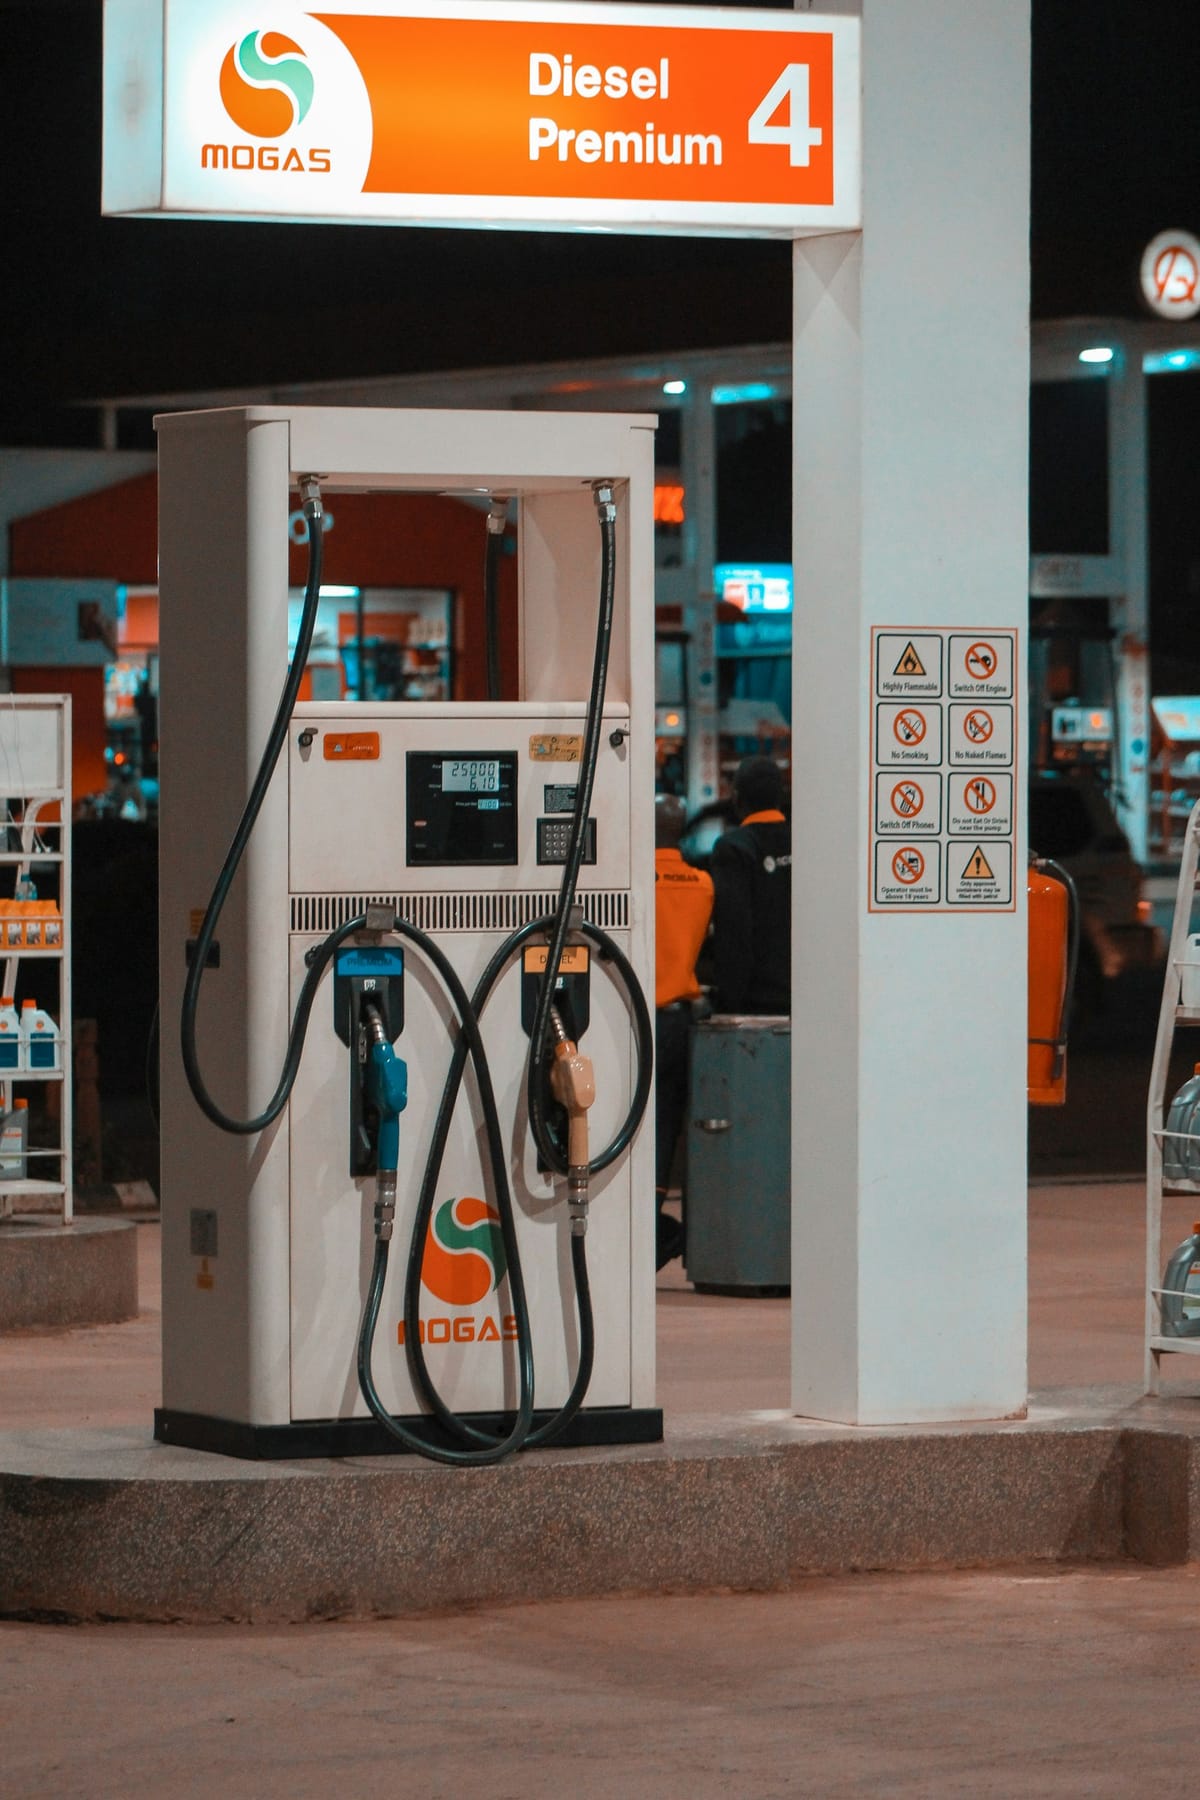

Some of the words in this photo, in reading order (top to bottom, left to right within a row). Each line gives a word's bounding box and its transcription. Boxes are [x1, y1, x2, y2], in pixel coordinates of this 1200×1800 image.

[528, 52, 670, 100] Diesel
[747, 62, 823, 168] 4
[528, 118, 723, 166] Premium
[200, 143, 331, 173] MOGAS
[883, 682, 903, 692] Highly
[986, 684, 1006, 693] Engine
[901, 751, 928, 760] Smoking
[452, 762, 496, 777] 25000
[540, 955, 573, 964] DEL
